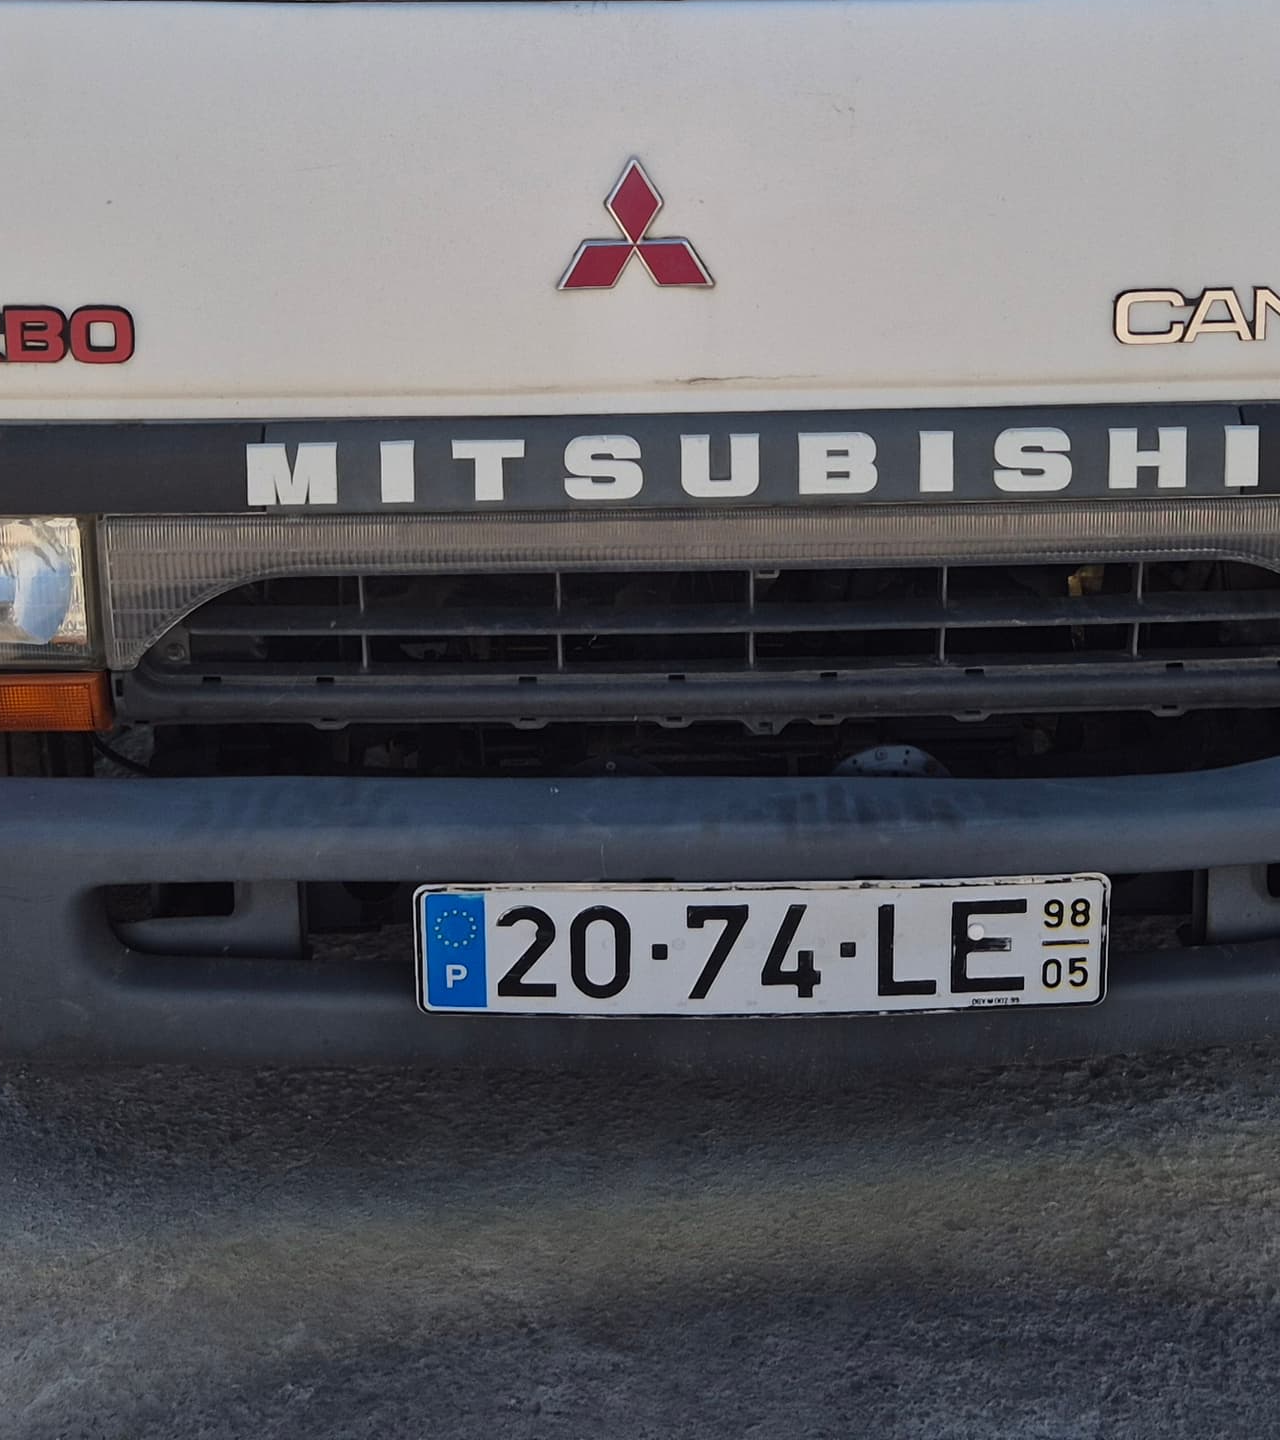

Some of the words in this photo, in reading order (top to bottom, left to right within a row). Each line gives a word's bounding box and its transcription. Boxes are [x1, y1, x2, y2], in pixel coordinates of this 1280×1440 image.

[246, 424, 1260, 507] MITSUBISHI
[1043, 898, 1091, 929] 98
[445, 964, 468, 989] P
[1042, 957, 1090, 989] 05
